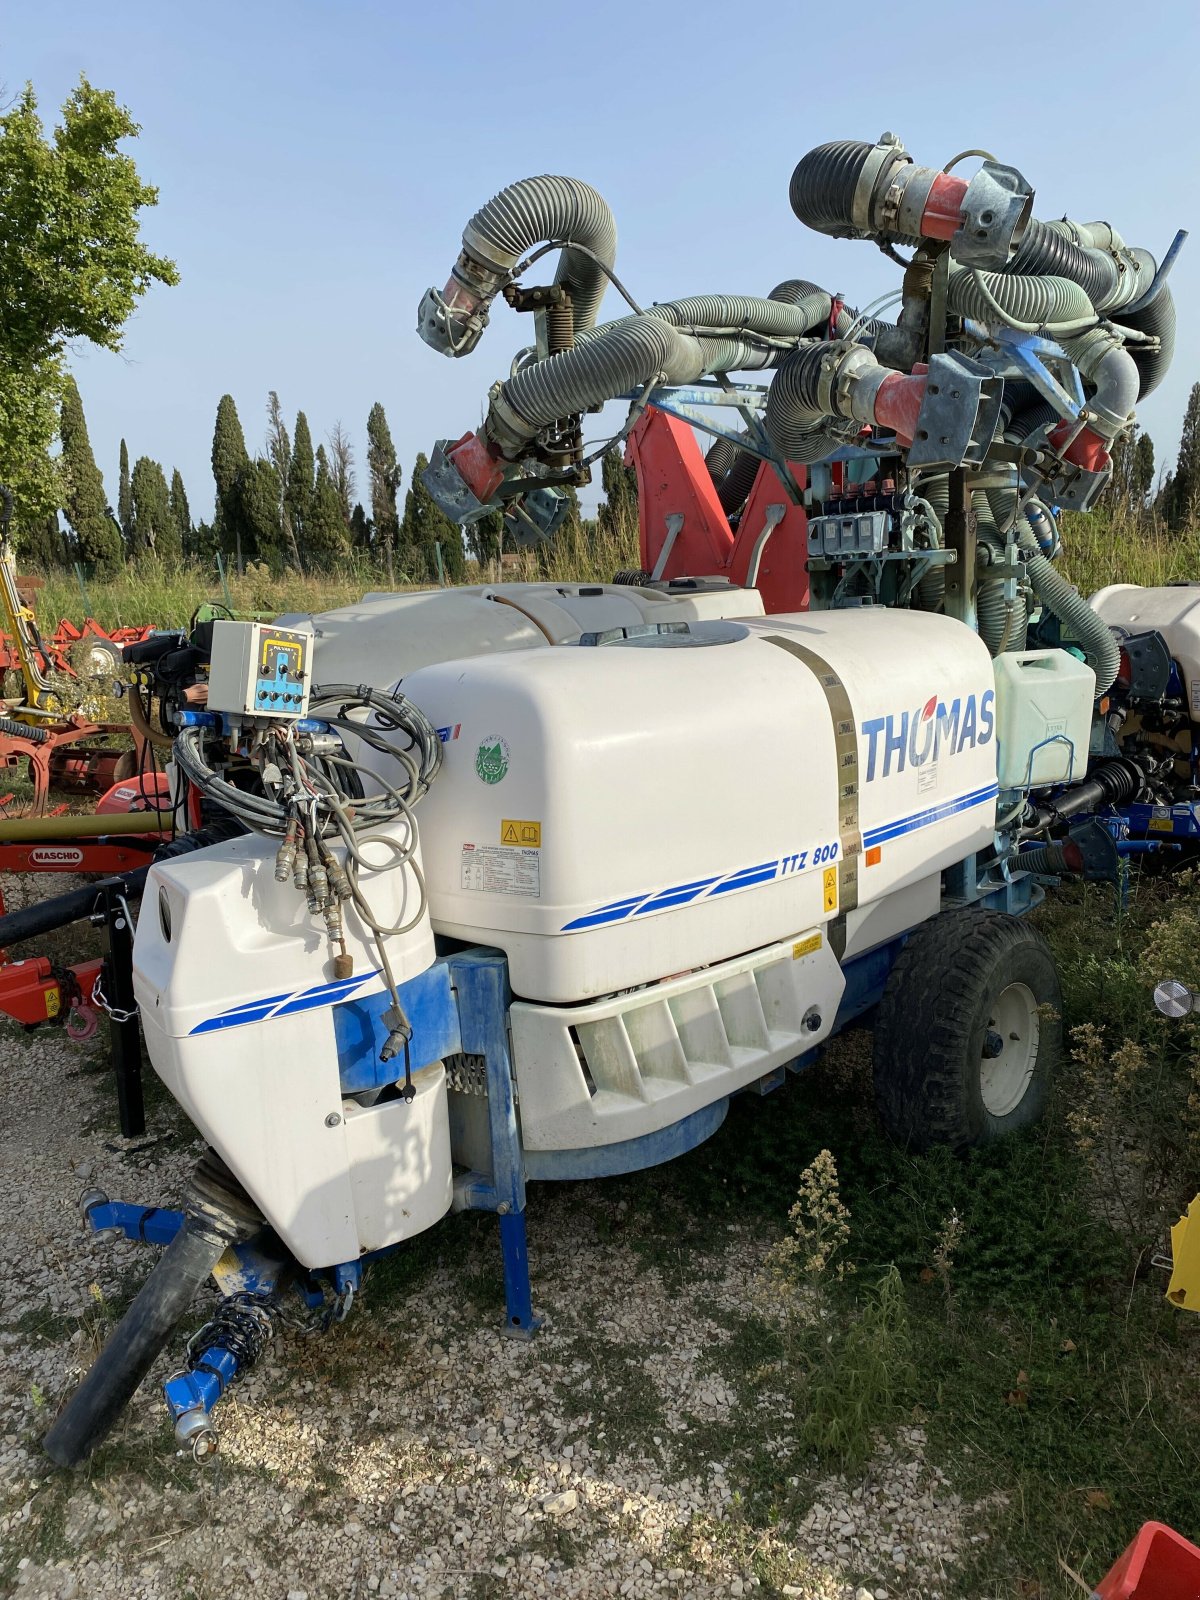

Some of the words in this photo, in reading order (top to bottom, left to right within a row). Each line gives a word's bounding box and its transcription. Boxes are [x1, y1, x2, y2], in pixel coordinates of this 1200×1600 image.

[862, 689, 995, 782] THOMAS
[34, 852, 80, 860] MASCHIO
[781, 850, 808, 875] TTZ
[813, 842, 839, 866] 800
